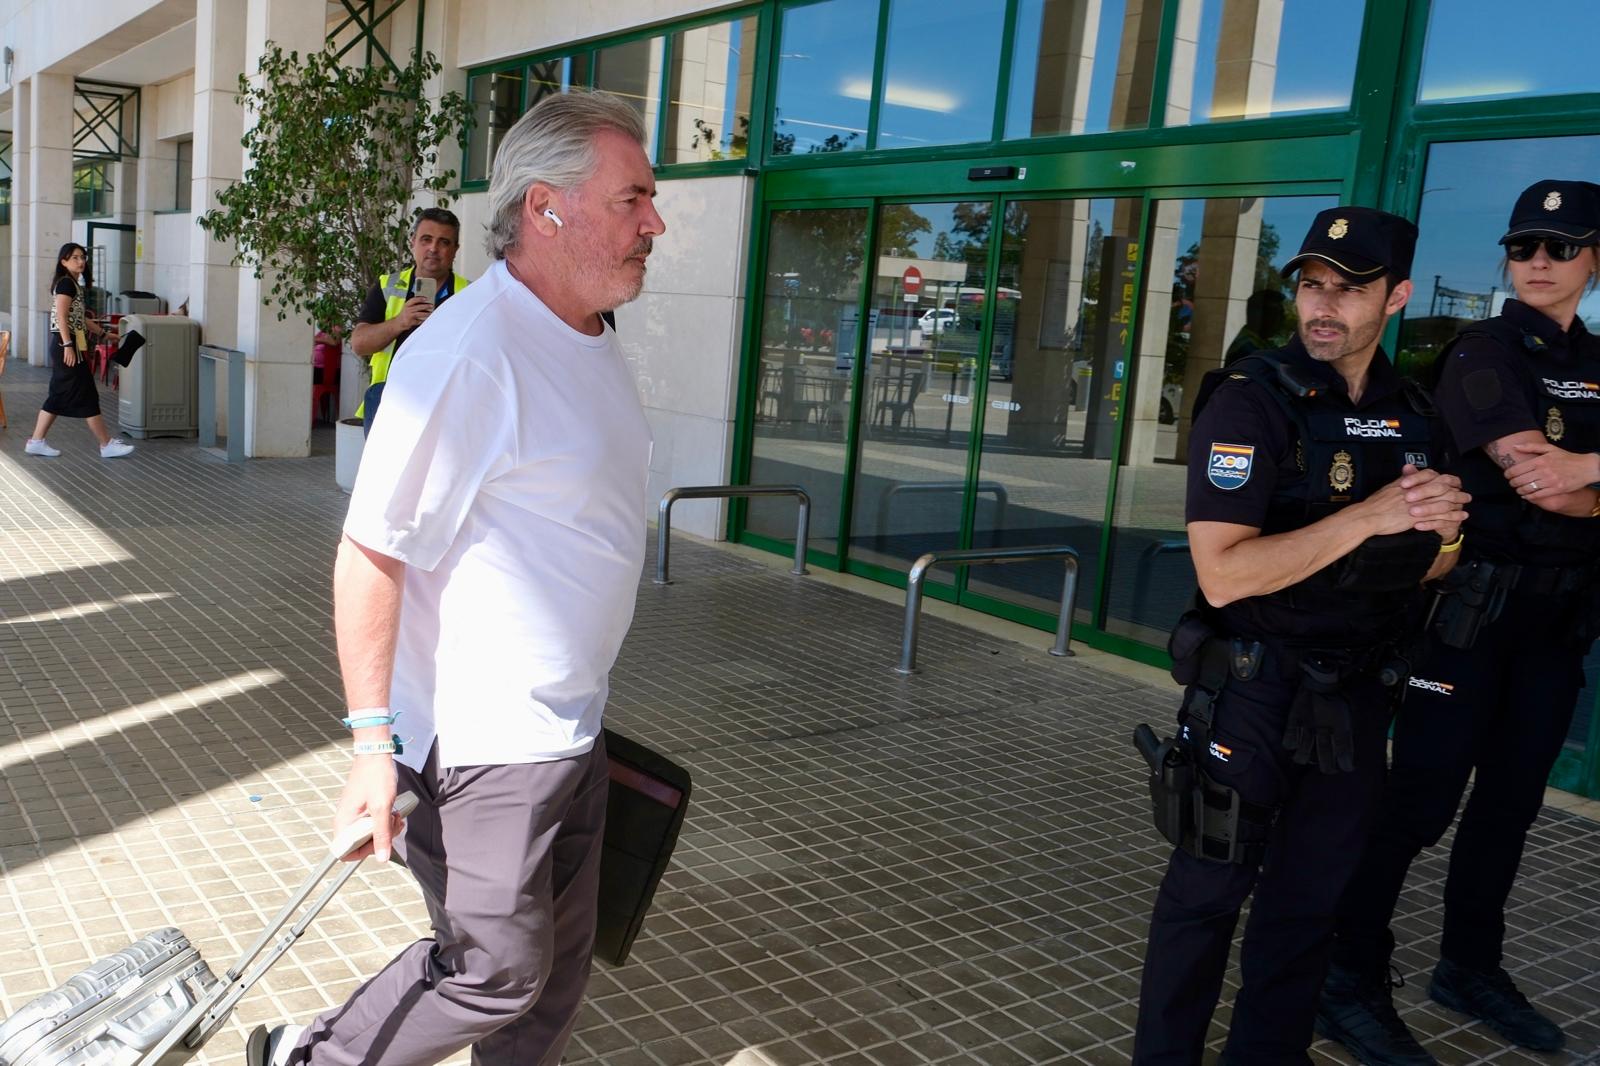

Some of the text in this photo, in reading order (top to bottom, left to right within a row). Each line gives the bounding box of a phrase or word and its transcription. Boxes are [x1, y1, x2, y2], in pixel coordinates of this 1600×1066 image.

[1542, 377, 1589, 389] POLICIA
[1343, 417, 1389, 428] POLICIA
[1346, 427, 1402, 437] NACIONAL
[1212, 454, 1248, 469] 200
